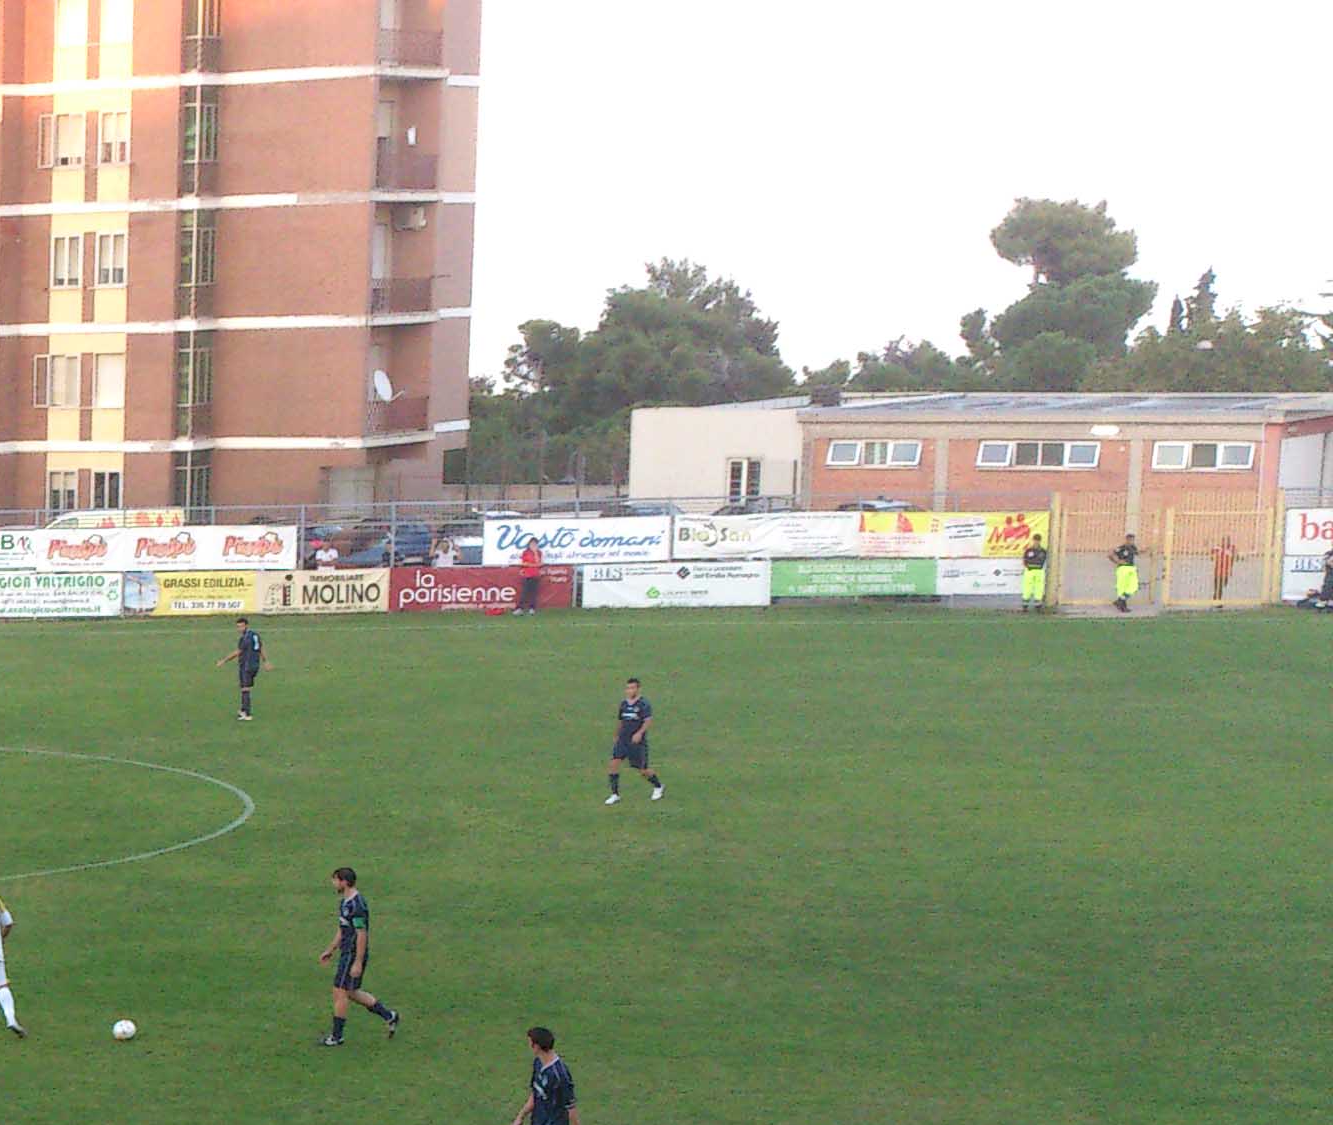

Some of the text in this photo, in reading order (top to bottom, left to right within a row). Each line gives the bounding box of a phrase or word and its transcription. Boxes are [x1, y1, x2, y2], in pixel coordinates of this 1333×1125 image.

[35, 575, 105, 588] VALTRIGNO
[163, 577, 245, 588] GRASSI EDILIZIA
[416, 570, 435, 587] la
[302, 583, 380, 605] MOLINO
[399, 584, 516, 608] parisienne
